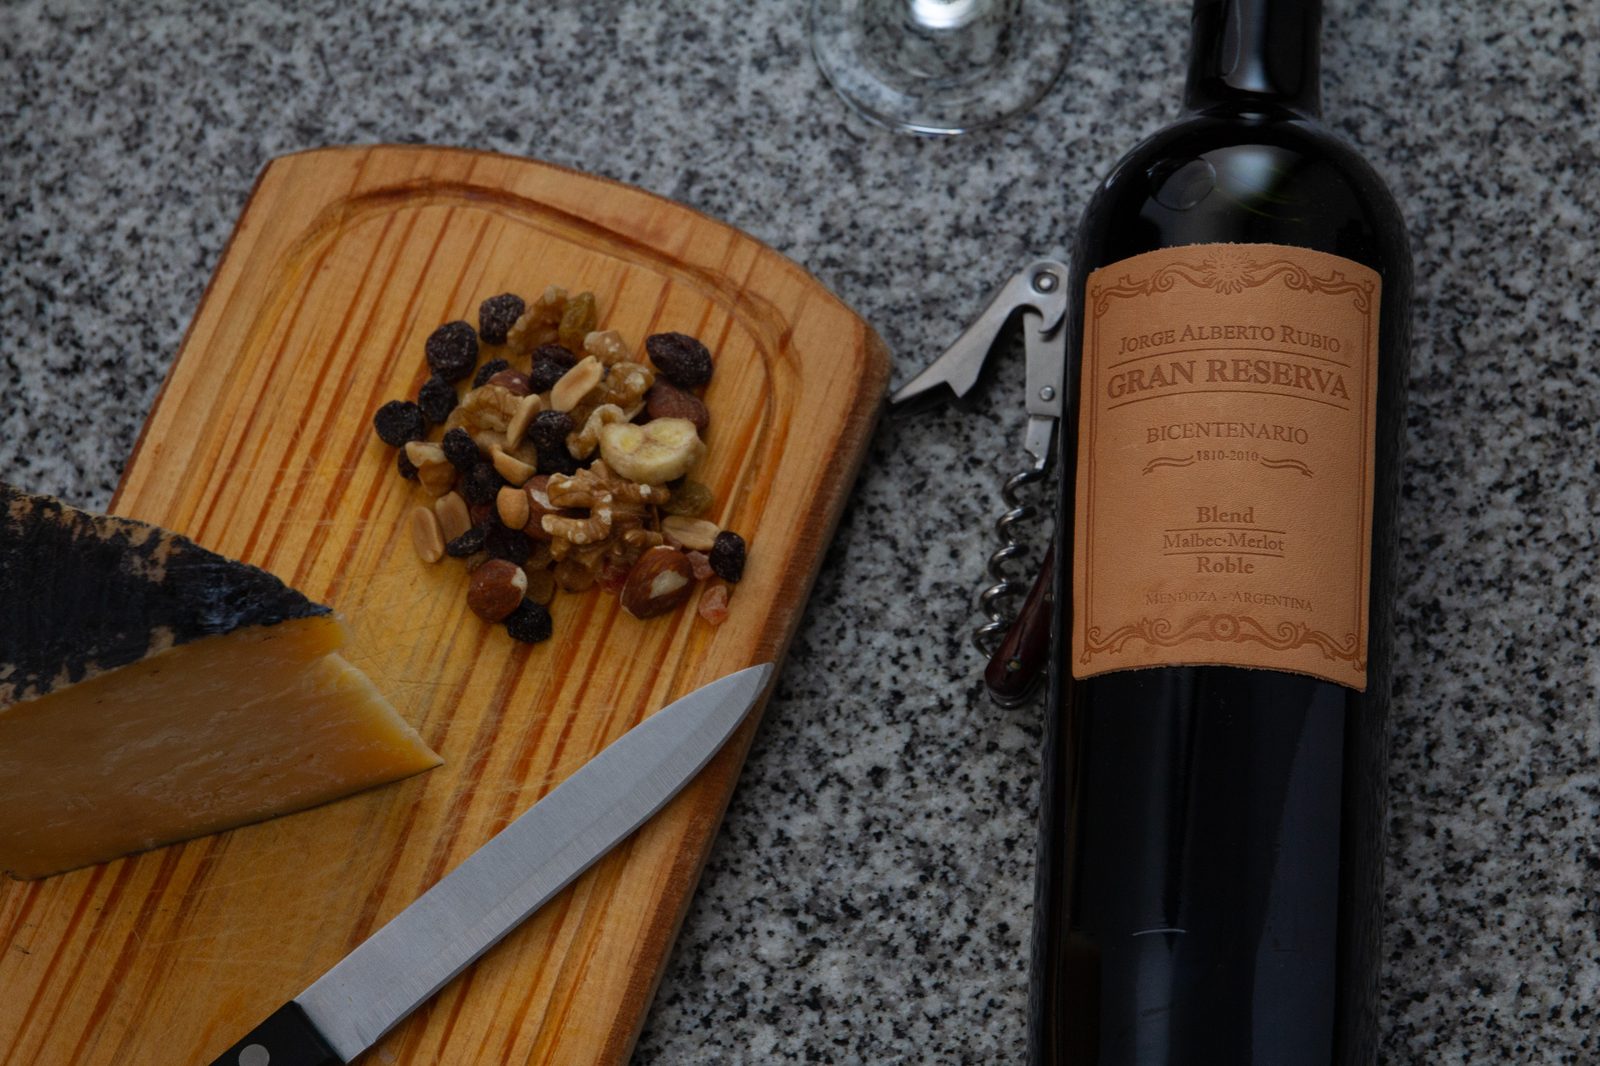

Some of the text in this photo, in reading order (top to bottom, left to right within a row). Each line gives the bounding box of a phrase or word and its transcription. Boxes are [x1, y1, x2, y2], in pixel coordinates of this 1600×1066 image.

[1118, 324, 1341, 355] JORGE ALBERTO RUBIO
[1107, 359, 1350, 401] GRAN RESERVA
[1146, 422, 1309, 445] BICENTENARIO
[1196, 506, 1255, 524] Blend
[1196, 557, 1255, 575] Roble
[1145, 591, 1217, 606] MENDOZA
[1233, 591, 1313, 612] ARGENTINA
